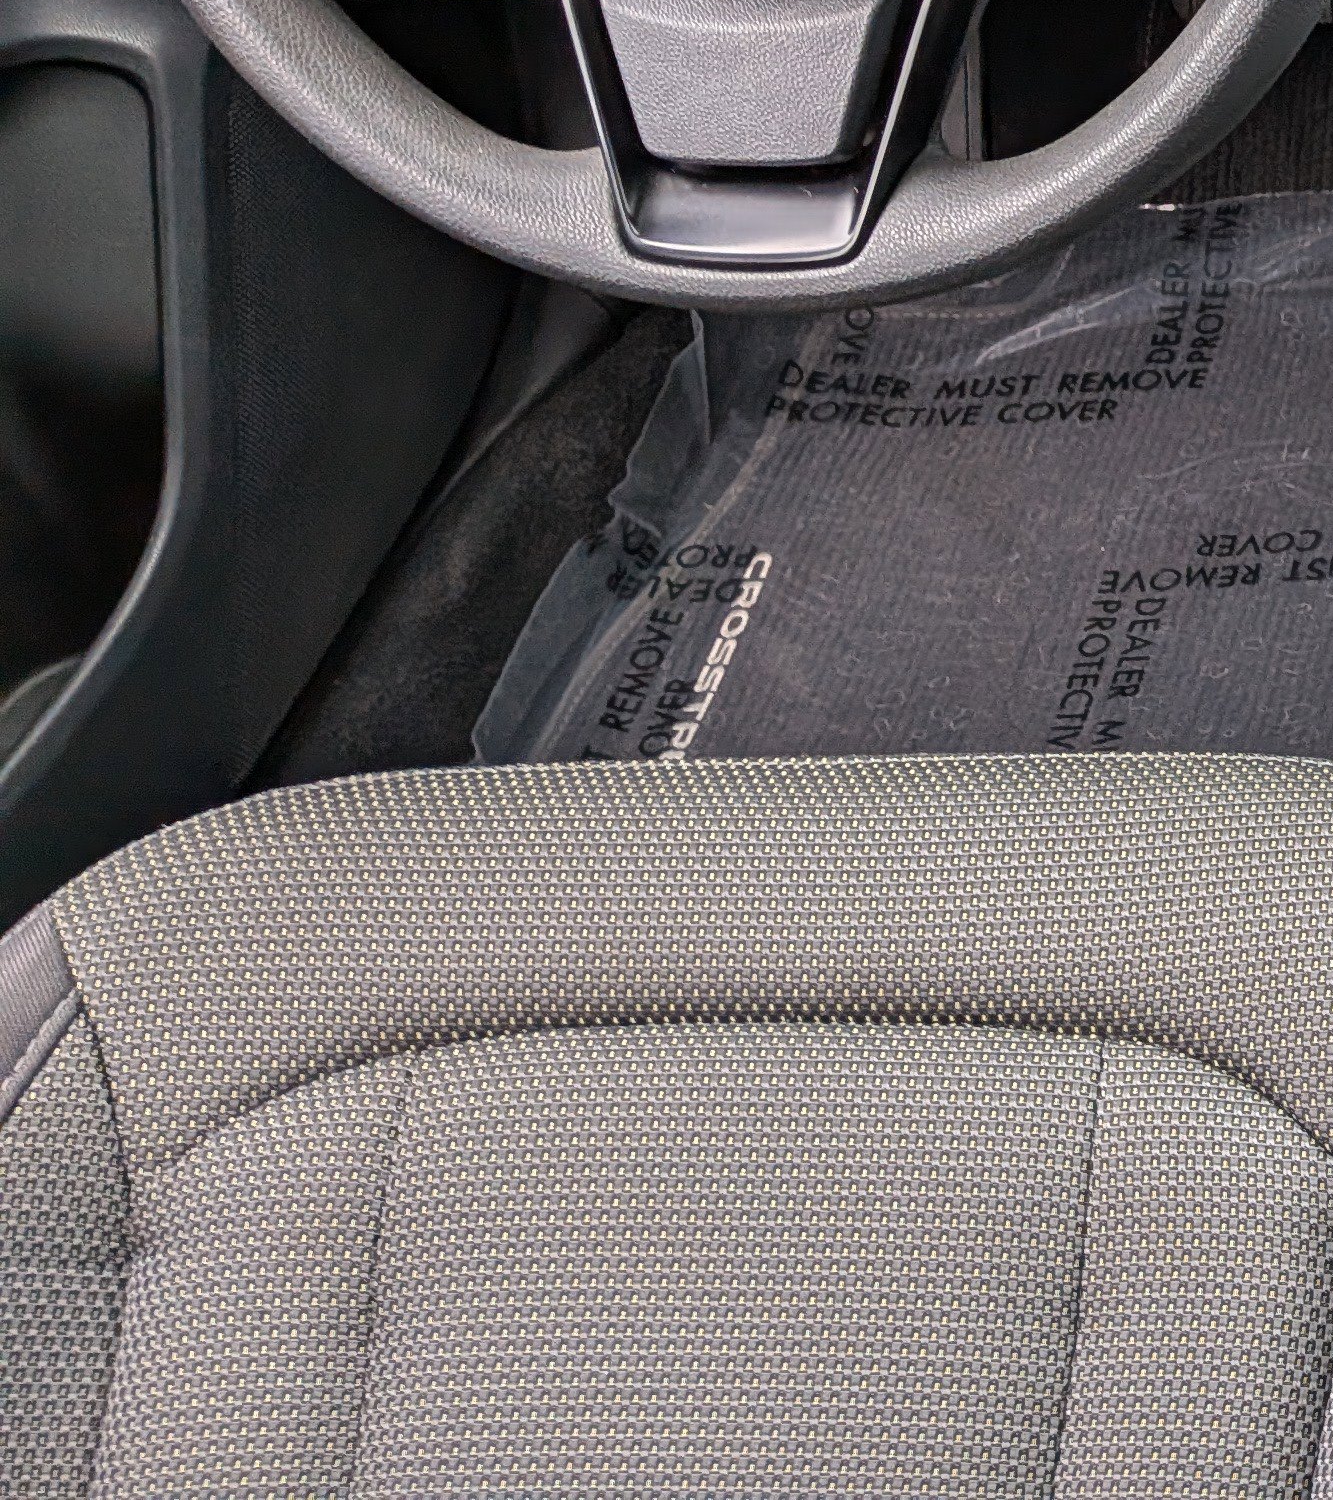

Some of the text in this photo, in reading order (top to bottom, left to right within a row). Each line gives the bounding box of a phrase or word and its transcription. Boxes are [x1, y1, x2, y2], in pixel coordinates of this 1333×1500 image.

[1145, 260, 1191, 365] DEALER
[1186, 202, 1242, 364] PROTECTIVE
[765, 395, 1119, 428] PROTECTIVE COVER
[778, 358, 1209, 400] DEALER MUST REMOVE
[1099, 561, 1261, 596] REMOVE
[1194, 529, 1321, 557] COVER
[600, 606, 685, 733] REMOVE
[659, 551, 774, 760] CROSSTR
[1046, 599, 1120, 751] PROTECTIV
[1104, 596, 1166, 700] DEALER
[638, 676, 698, 758] OVER
